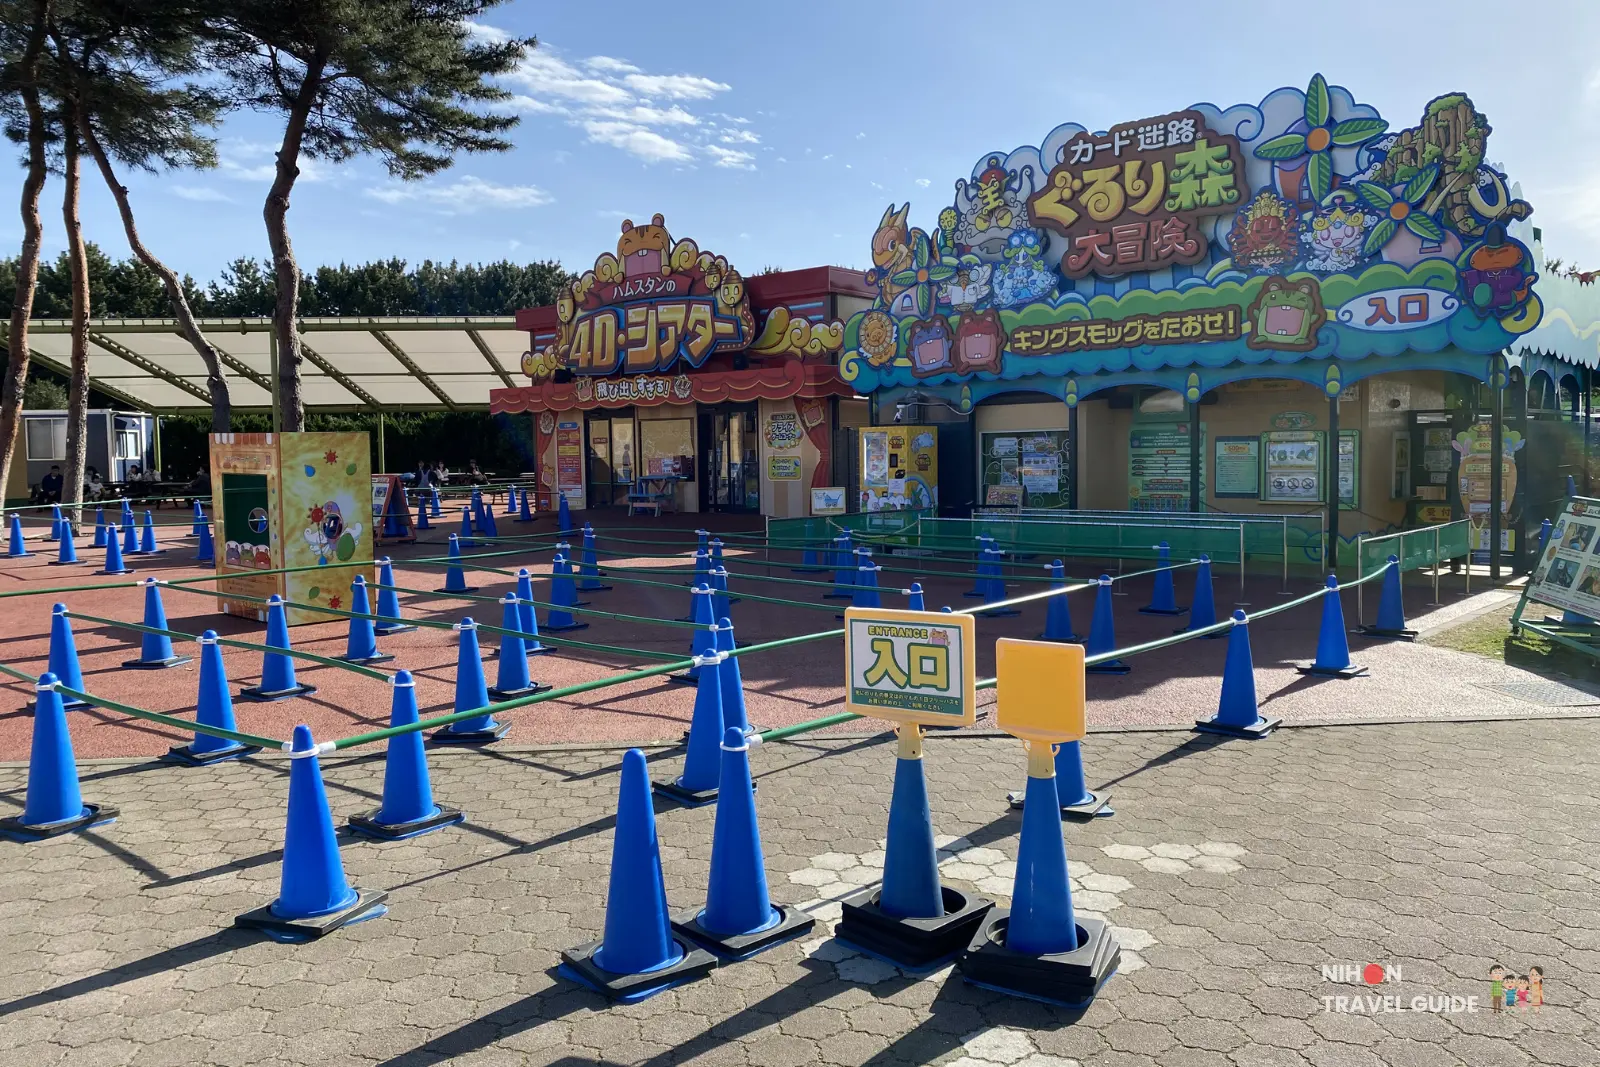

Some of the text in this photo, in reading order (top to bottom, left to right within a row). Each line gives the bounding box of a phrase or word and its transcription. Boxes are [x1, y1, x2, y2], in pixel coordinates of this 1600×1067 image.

[1069, 118, 1198, 165] カード迷路
[1031, 138, 1237, 228] ぐるり森
[1067, 216, 1198, 269] 大冒険
[612, 279, 676, 299] ハムスタンの
[1365, 294, 1430, 325] 入口
[867, 625, 929, 639] ENTRANCE
[863, 637, 950, 691] 入口
